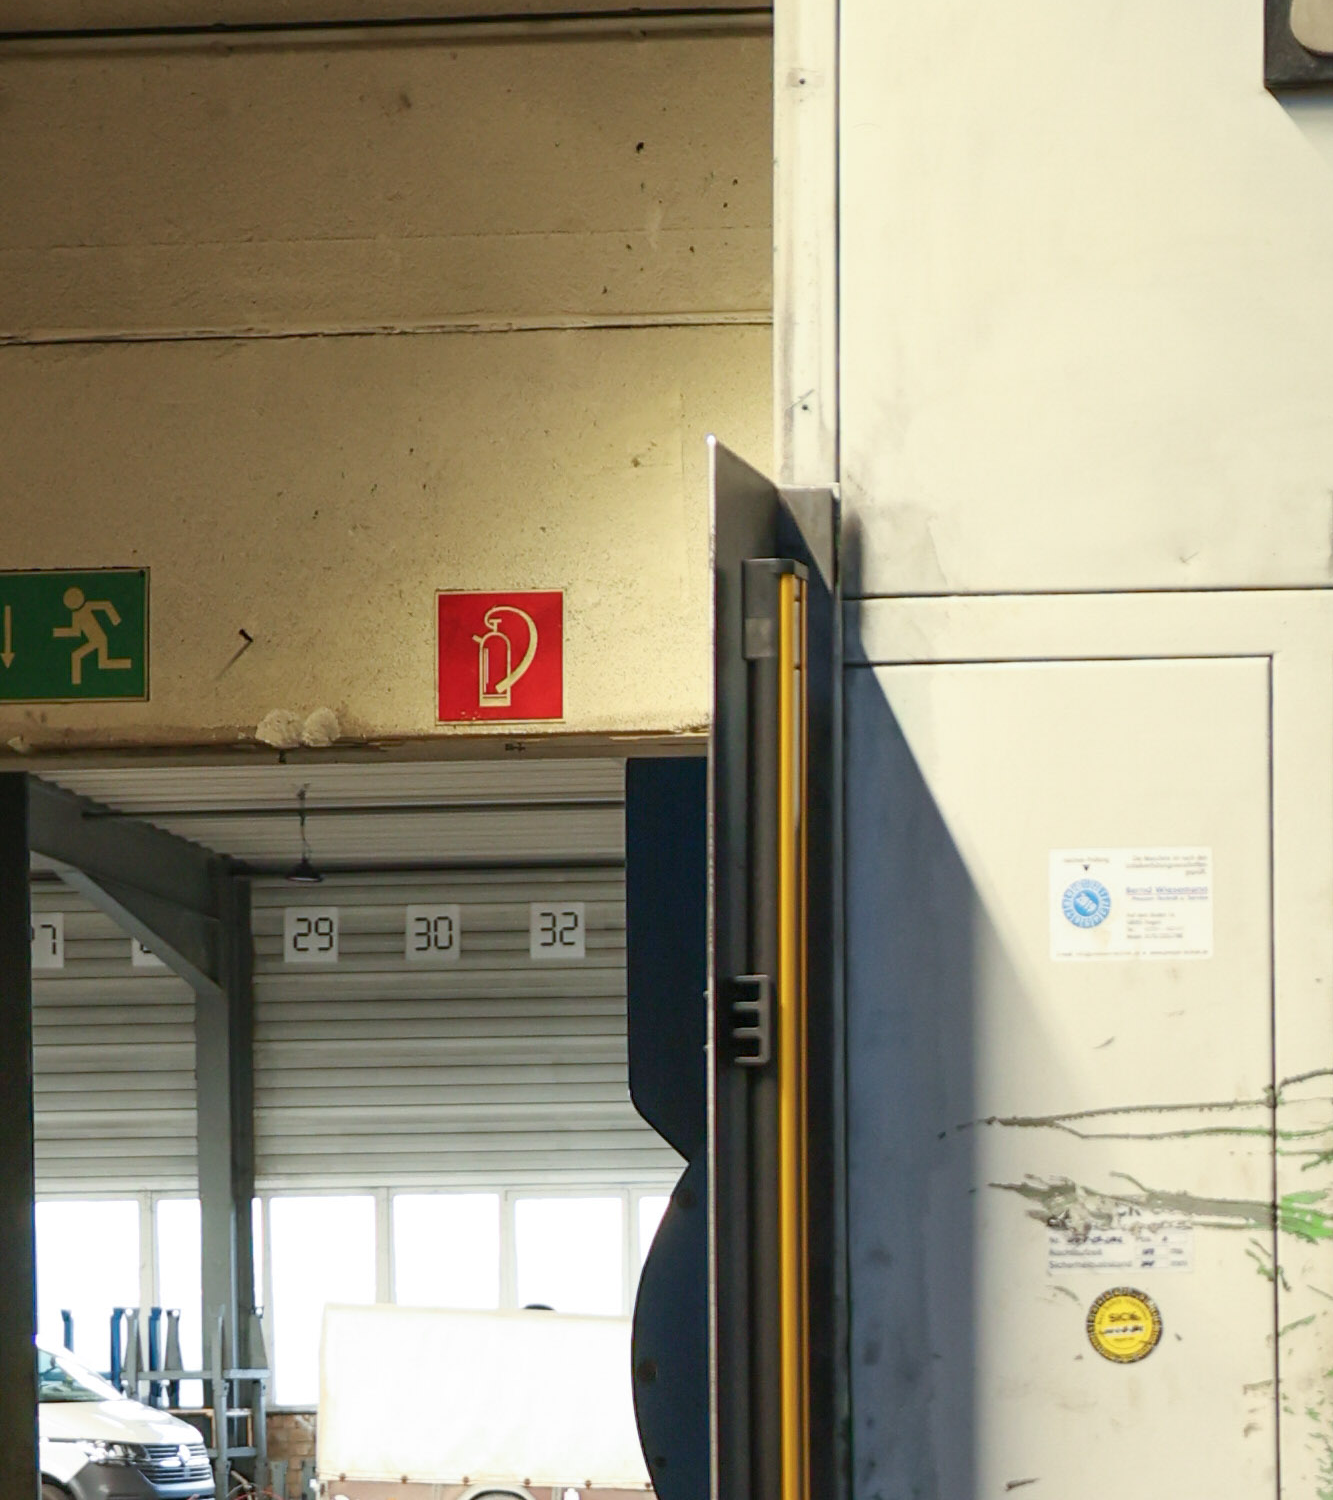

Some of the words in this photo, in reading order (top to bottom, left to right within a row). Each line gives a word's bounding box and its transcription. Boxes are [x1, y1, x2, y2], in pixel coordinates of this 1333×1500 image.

[32, 924, 57, 955] 7
[293, 916, 333, 951] 29
[414, 916, 453, 950] 30
[540, 911, 578, 946] 32
